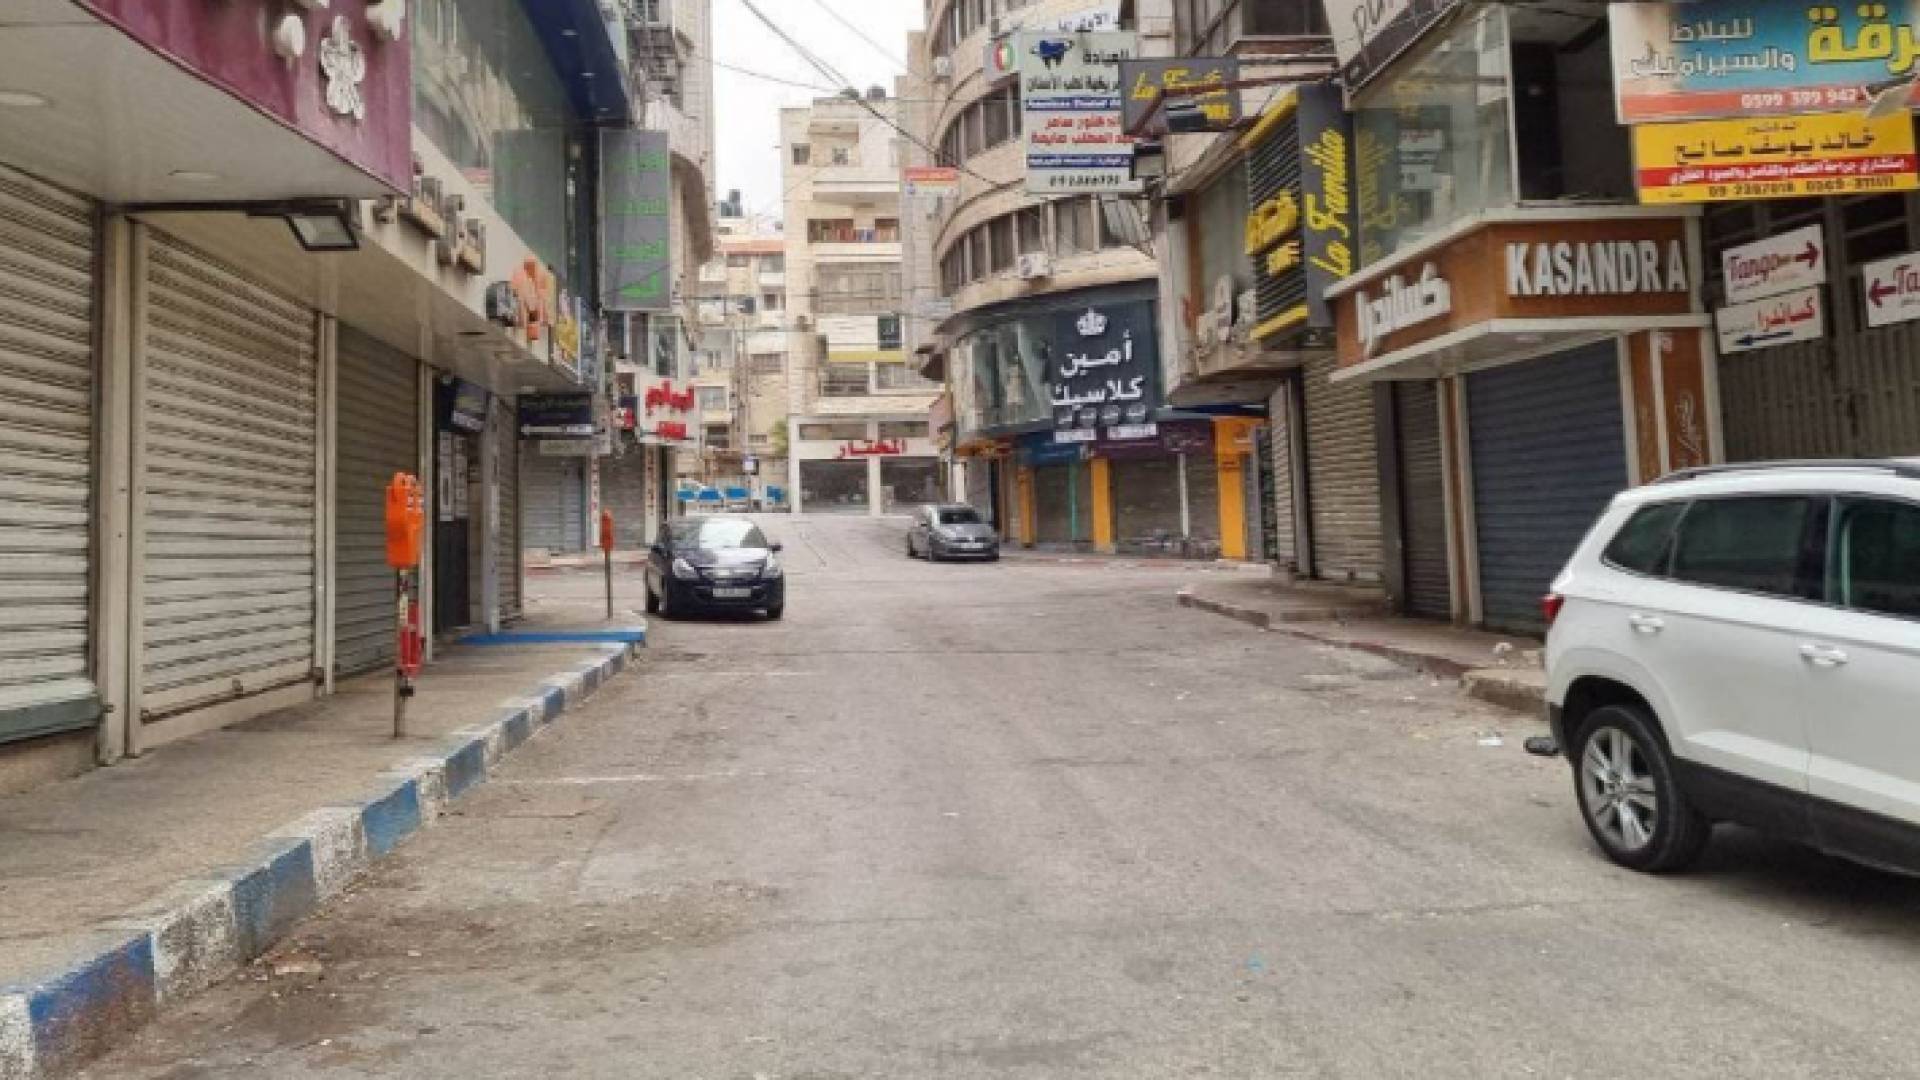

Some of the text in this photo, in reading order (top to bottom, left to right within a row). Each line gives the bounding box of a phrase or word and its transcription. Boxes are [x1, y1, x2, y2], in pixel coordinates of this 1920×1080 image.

[1671, 17, 1752, 43] للبلاط
[1807, 4, 1920, 75] رقة
[1631, 41, 1796, 77] والسيراميك
[1741, 93, 1782, 109] 0599
[1790, 90, 1822, 106] 399
[1675, 127, 1874, 166] خالد يوسف صالح
[1309, 240, 1351, 277] La
[1505, 240, 1688, 296] KASANDRA
[1729, 253, 1779, 281] Tango
[1356, 261, 1451, 357] كساندرا
[1060, 329, 1132, 378] أمين
[1050, 376, 1144, 409] كلاسيك
